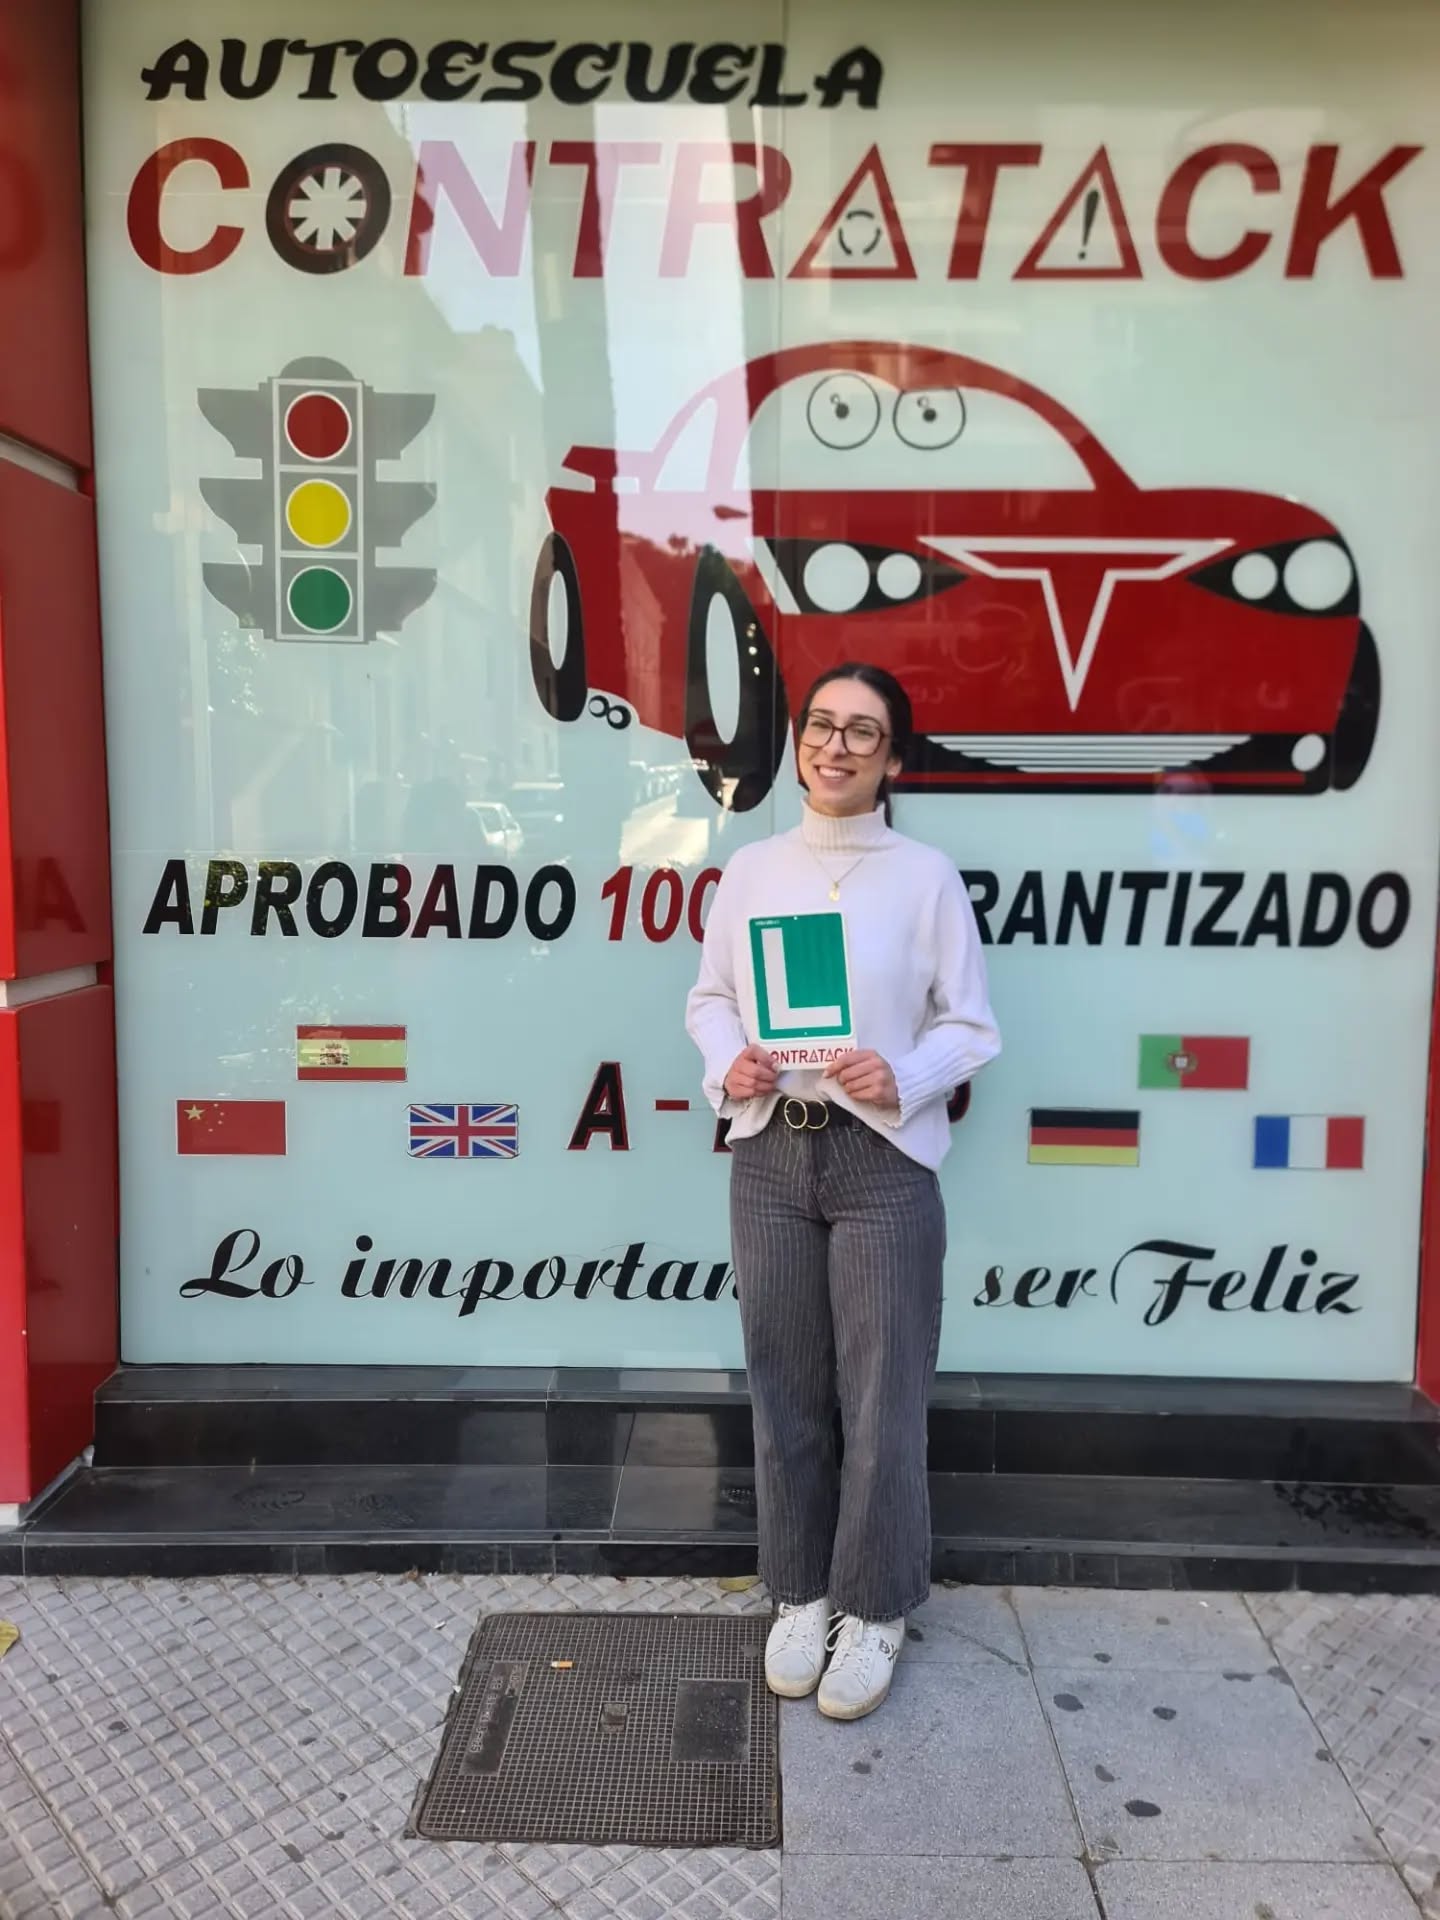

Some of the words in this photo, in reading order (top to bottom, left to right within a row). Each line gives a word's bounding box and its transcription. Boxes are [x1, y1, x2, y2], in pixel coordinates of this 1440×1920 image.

[140, 38, 884, 110] AUTOESCUELA
[126, 136, 1426, 281] CONTRATACK
[142, 858, 577, 943] APROBADO
[958, 868, 1411, 949] RANTIZADO
[760, 926, 843, 1031] L
[770, 1047, 854, 1065] ONTRATAC
[567, 1061, 630, 1151] A
[179, 1228, 316, 1299] Lo
[341, 1234, 739, 1318] importan
[973, 1265, 1098, 1308] ser
[1111, 1239, 1364, 1327] Feliz
